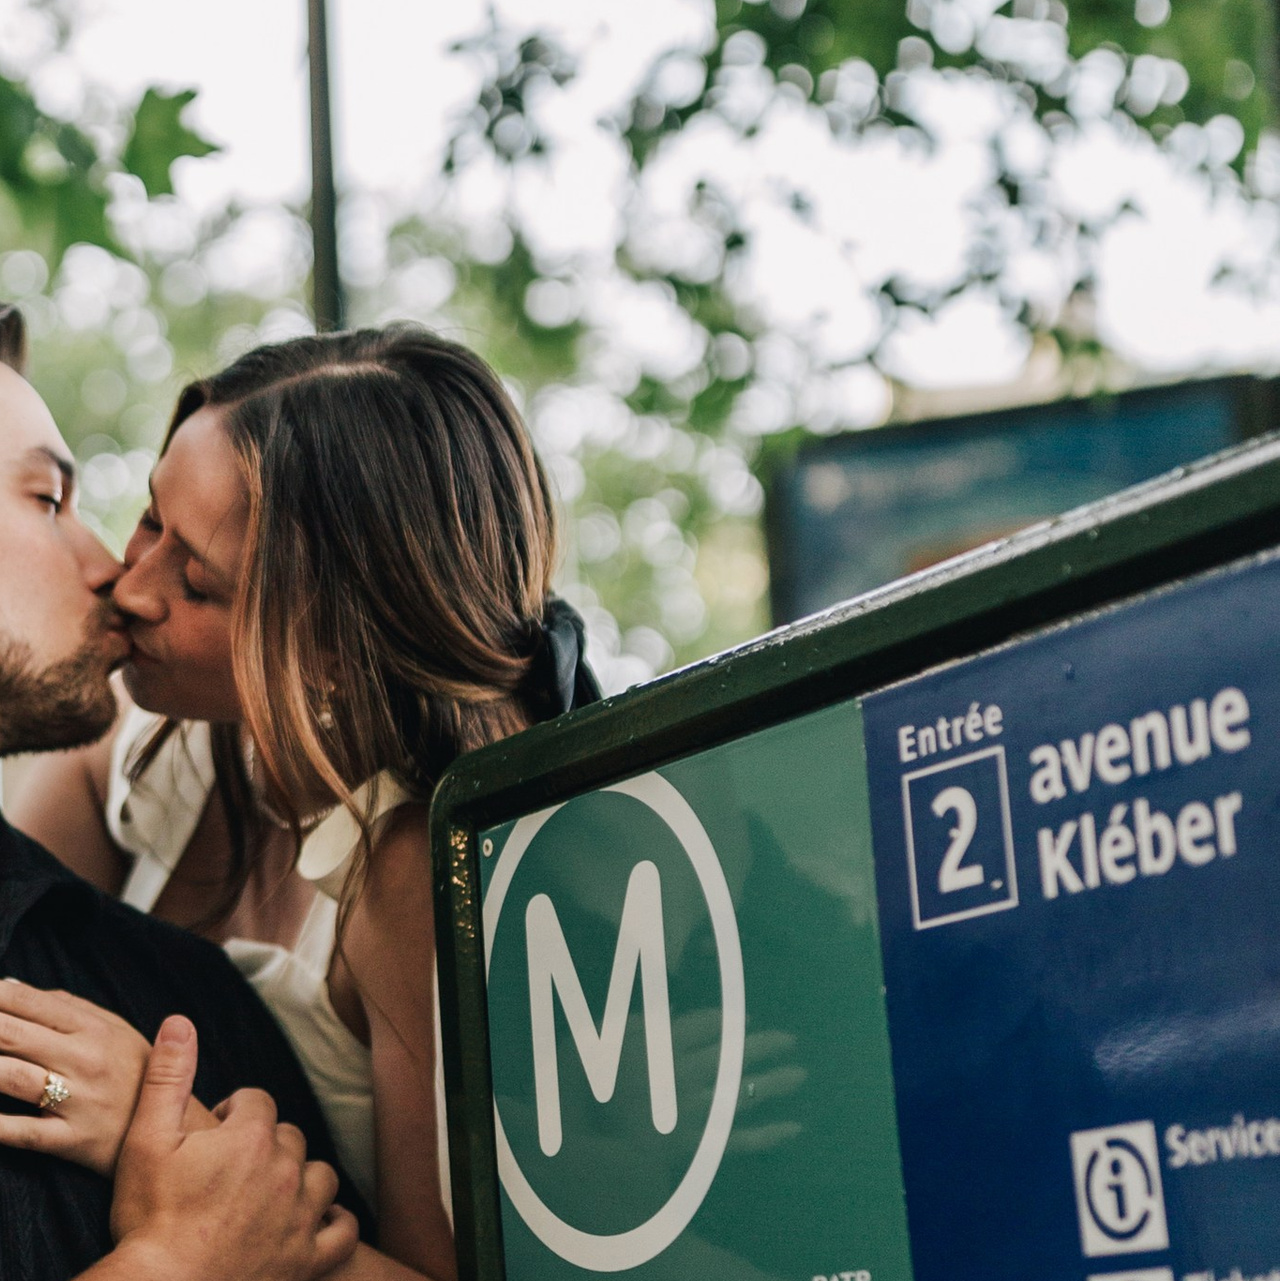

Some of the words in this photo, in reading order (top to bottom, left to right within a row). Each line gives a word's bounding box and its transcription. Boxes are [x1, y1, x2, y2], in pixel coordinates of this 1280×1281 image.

[897, 701, 1005, 763] Entrée
[1028, 686, 1252, 805] avenue
[930, 785, 985, 894] 2
[1037, 790, 1244, 900] Kléber
[525, 860, 678, 1157] M
